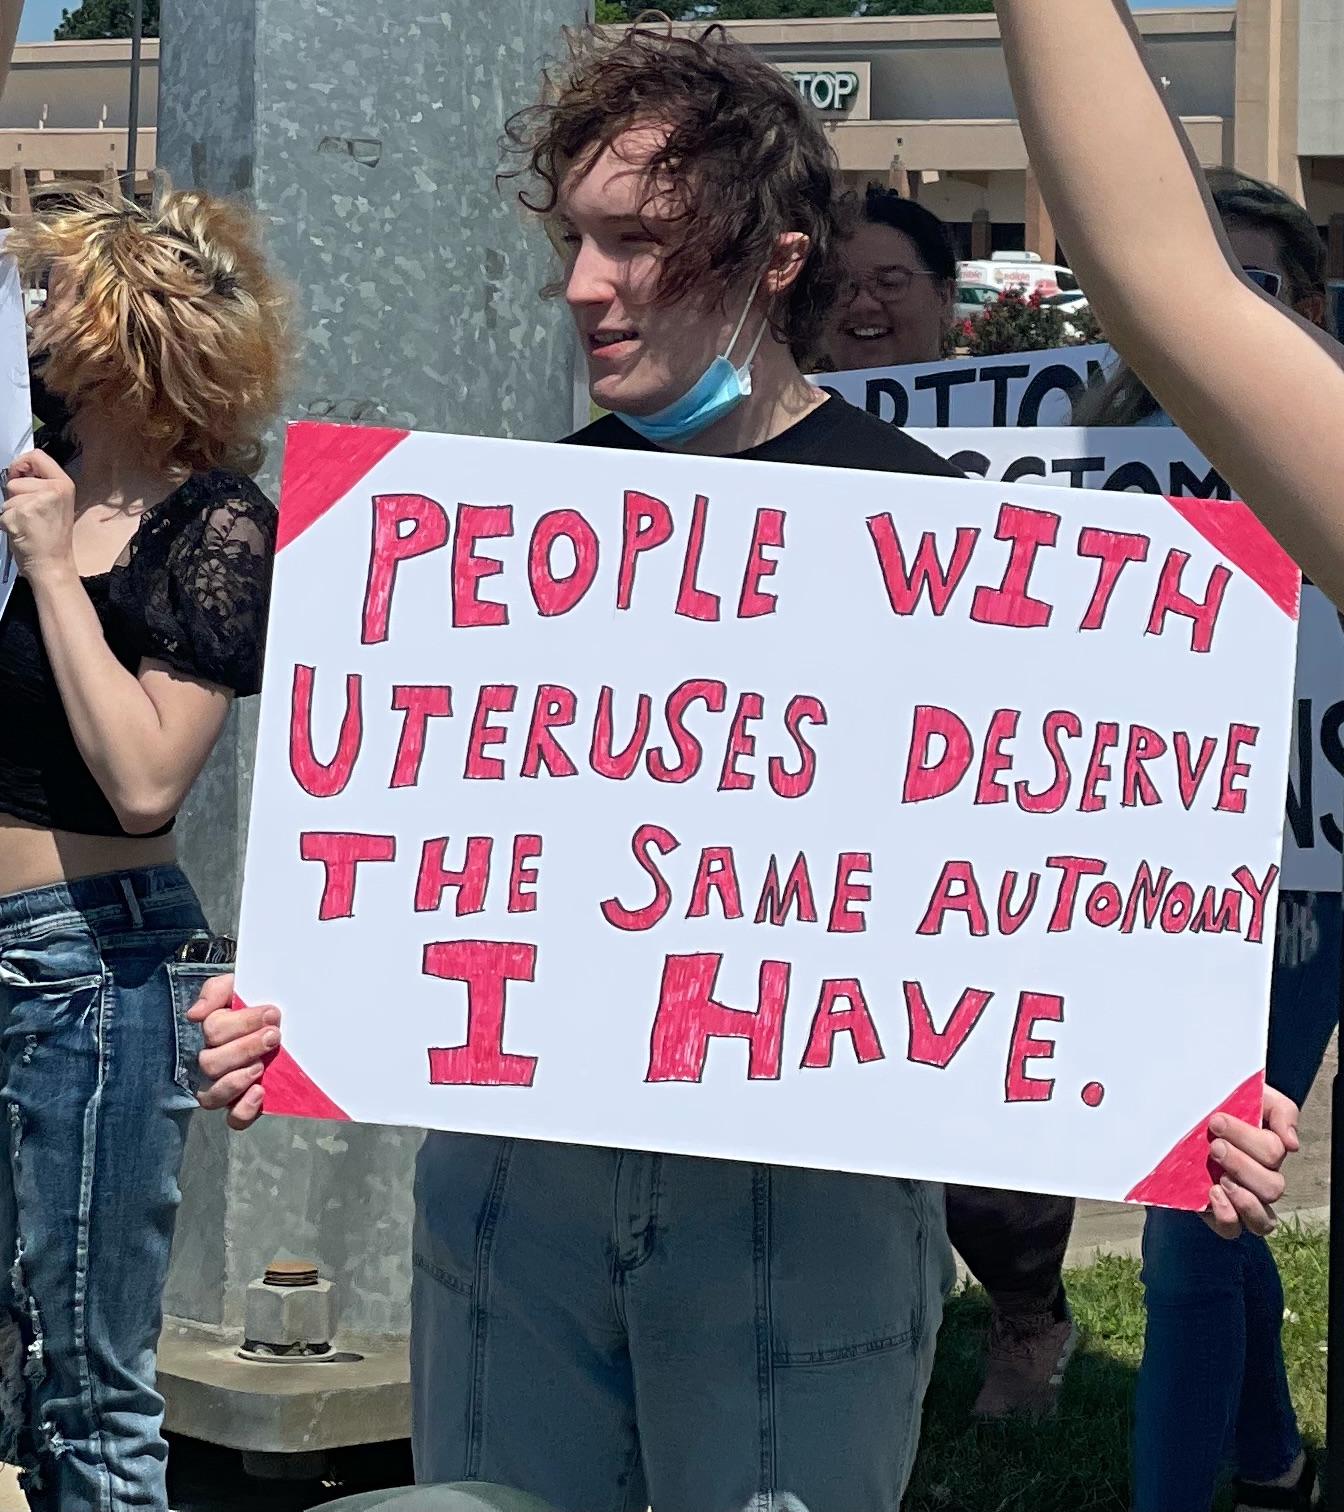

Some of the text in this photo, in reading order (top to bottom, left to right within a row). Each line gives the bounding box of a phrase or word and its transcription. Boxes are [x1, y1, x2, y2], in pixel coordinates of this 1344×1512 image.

[360, 489, 1234, 654] PEOPLE WITH
[289, 663, 828, 799] UTERUSES
[900, 703, 1260, 815] DESERVE
[299, 823, 1280, 944] THE SAME AUTONOMY
[421, 939, 1107, 1110] I HAVE.
